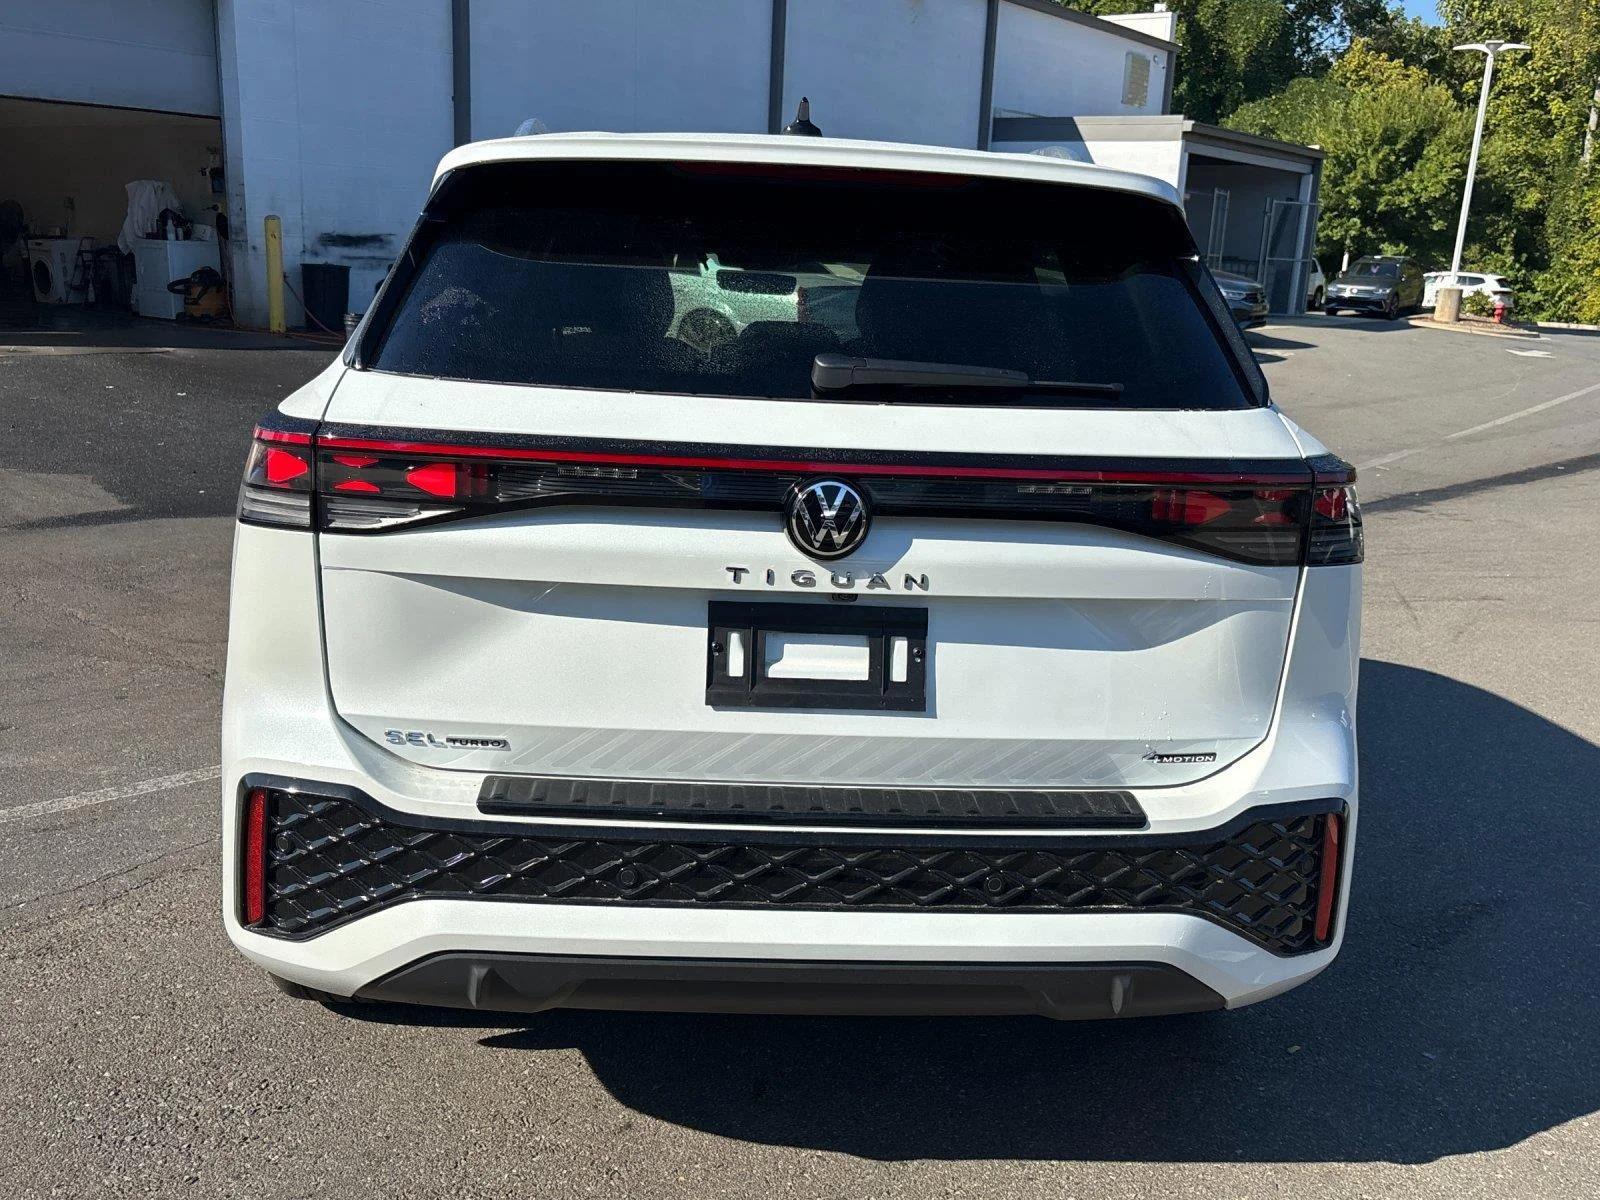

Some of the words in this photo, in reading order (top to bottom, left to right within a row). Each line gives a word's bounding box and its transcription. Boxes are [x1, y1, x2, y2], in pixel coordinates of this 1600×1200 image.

[725, 566, 929, 592] TIGUAN
[384, 728, 448, 749] SEL
[449, 736, 505, 750] TURBO
